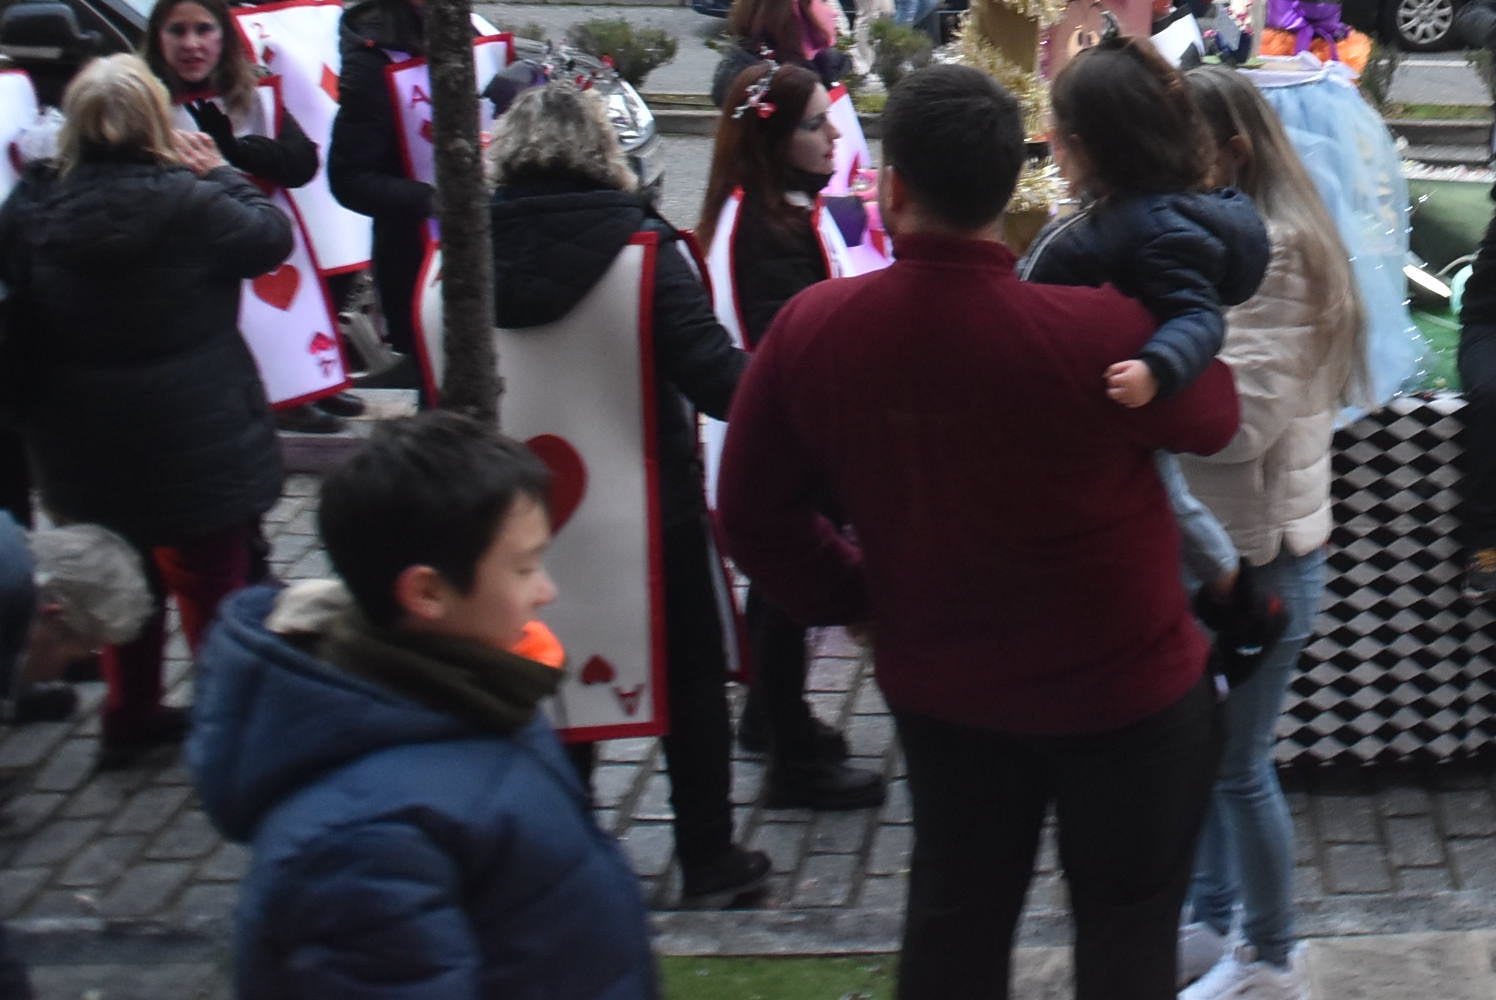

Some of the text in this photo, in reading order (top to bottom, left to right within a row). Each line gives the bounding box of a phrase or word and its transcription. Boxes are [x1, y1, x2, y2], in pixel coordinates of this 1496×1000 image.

[252, 22, 271, 39] 2
[412, 84, 432, 109] A
[613, 683, 645, 717] A
